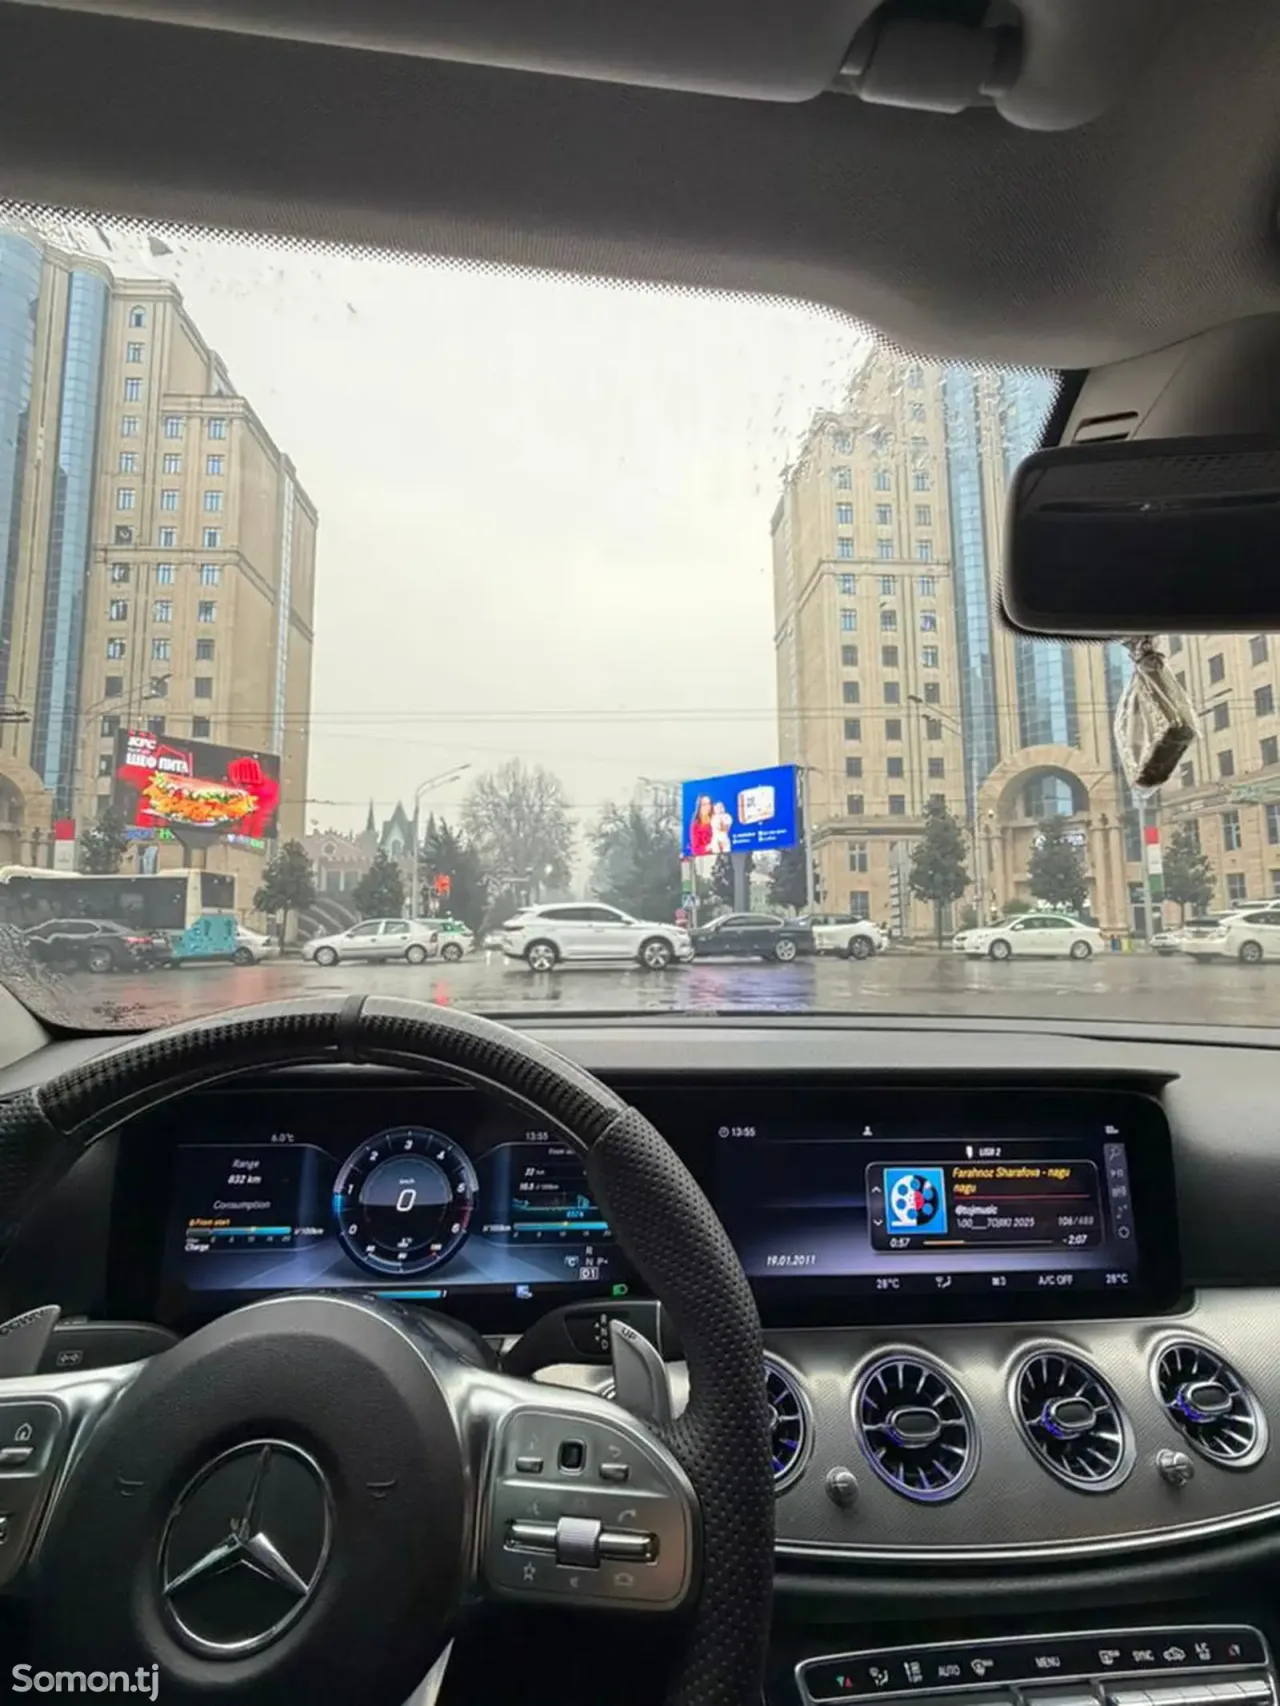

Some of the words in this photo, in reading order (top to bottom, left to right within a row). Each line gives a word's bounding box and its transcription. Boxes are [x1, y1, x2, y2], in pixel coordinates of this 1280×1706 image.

[158, 757, 189, 773] ПИТА
[526, 1132, 548, 1140] 13:55
[731, 1127, 756, 1137] 13:55
[404, 1139, 413, 1150] 3
[369, 1150, 379, 1161] 2
[436, 1150, 445, 1160] 4
[232, 1159, 260, 1170] Range
[247, 1174, 262, 1184] km
[1047, 1168, 1071, 1179] nagu
[348, 1184, 354, 1195] 1
[953, 1183, 977, 1195] nagu
[213, 1200, 271, 1211] Consumption
[396, 1189, 417, 1212] 0
[1013, 1216, 1036, 1228] 2025
[348, 1224, 358, 1235] 0
[184, 1243, 210, 1252] Charge
[890, 1238, 910, 1248] 0:57
[586, 1246, 593, 1255] R
[586, 1258, 593, 1266] N
[767, 1254, 816, 1266] 19.01.2011
[1038, 1275, 1055, 1286] A/C
[1056, 1274, 1073, 1285] OFF
[621, 1328, 638, 1340] UP
[938, 1664, 961, 1678] AUTO
[1035, 1656, 1061, 1669] MENU
[1132, 1649, 1155, 1663] SYNC
